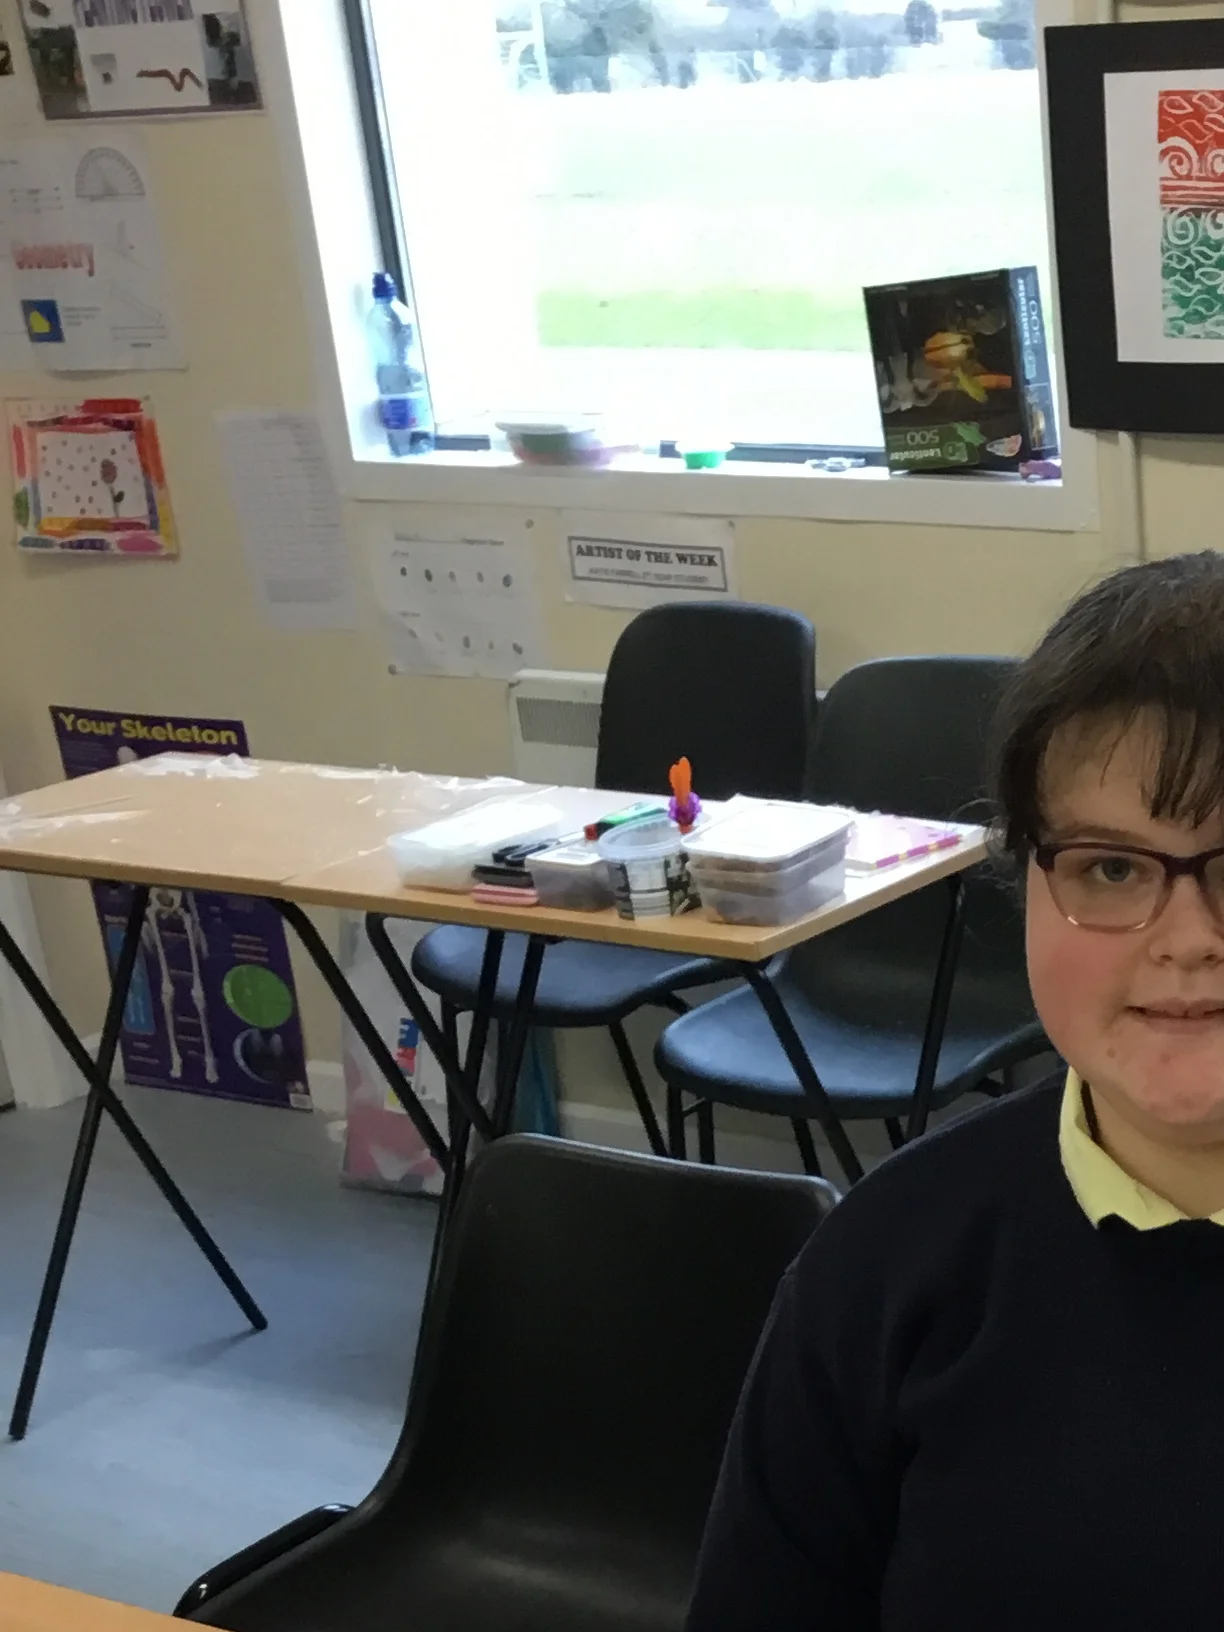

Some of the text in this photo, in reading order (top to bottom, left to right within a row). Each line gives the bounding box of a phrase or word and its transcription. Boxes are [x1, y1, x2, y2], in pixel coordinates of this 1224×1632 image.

[1028, 299, 1042, 344] 500
[906, 428, 941, 447] 500
[575, 544, 718, 567] ARTIST OF THE WEEK
[58, 712, 239, 746] Your Skeleton
